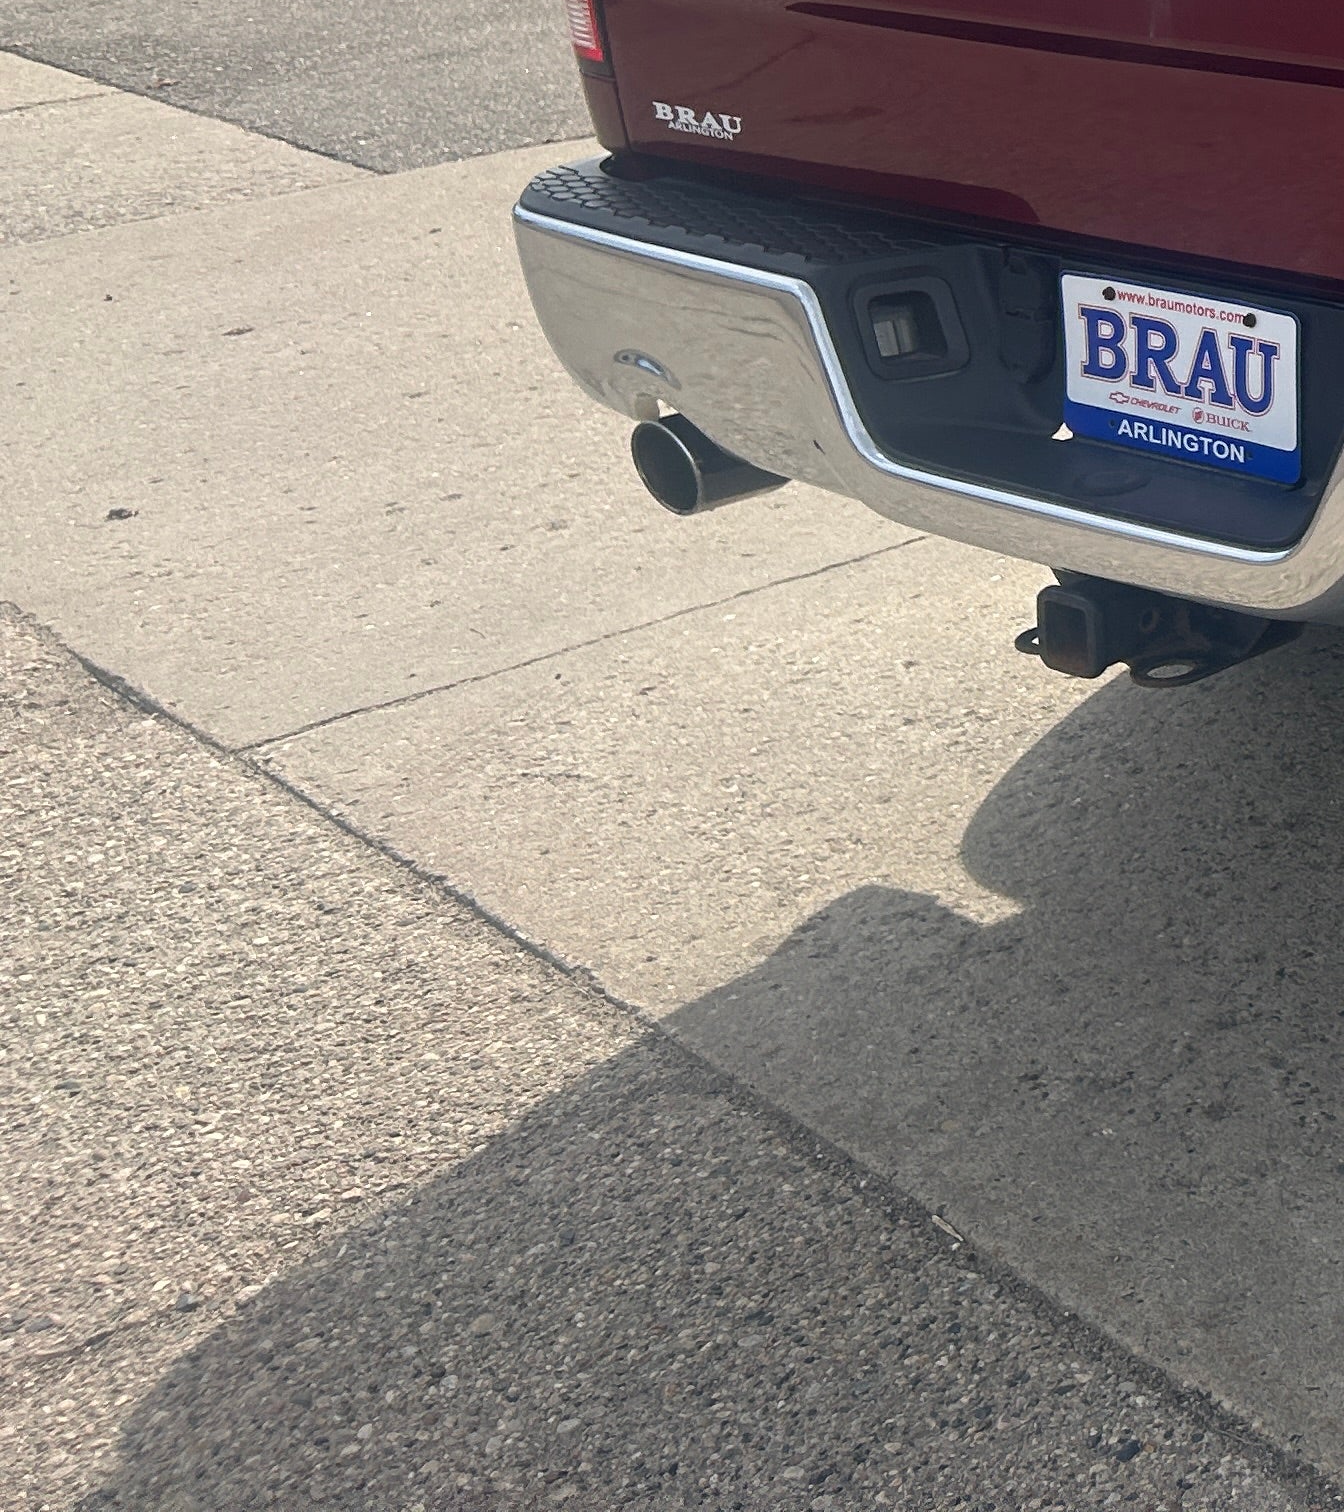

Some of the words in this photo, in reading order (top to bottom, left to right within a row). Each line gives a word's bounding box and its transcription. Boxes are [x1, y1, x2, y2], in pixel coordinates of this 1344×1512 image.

[651, 100, 742, 134] BRAU
[668, 120, 734, 141] ARLINGTON
[1116, 289, 1248, 325] www.braumotors.com
[1077, 302, 1281, 418] BRAU
[1130, 397, 1182, 415] CHEVROLET
[1206, 413, 1250, 432] BUICK
[1117, 418, 1246, 464] ARLINGTON
